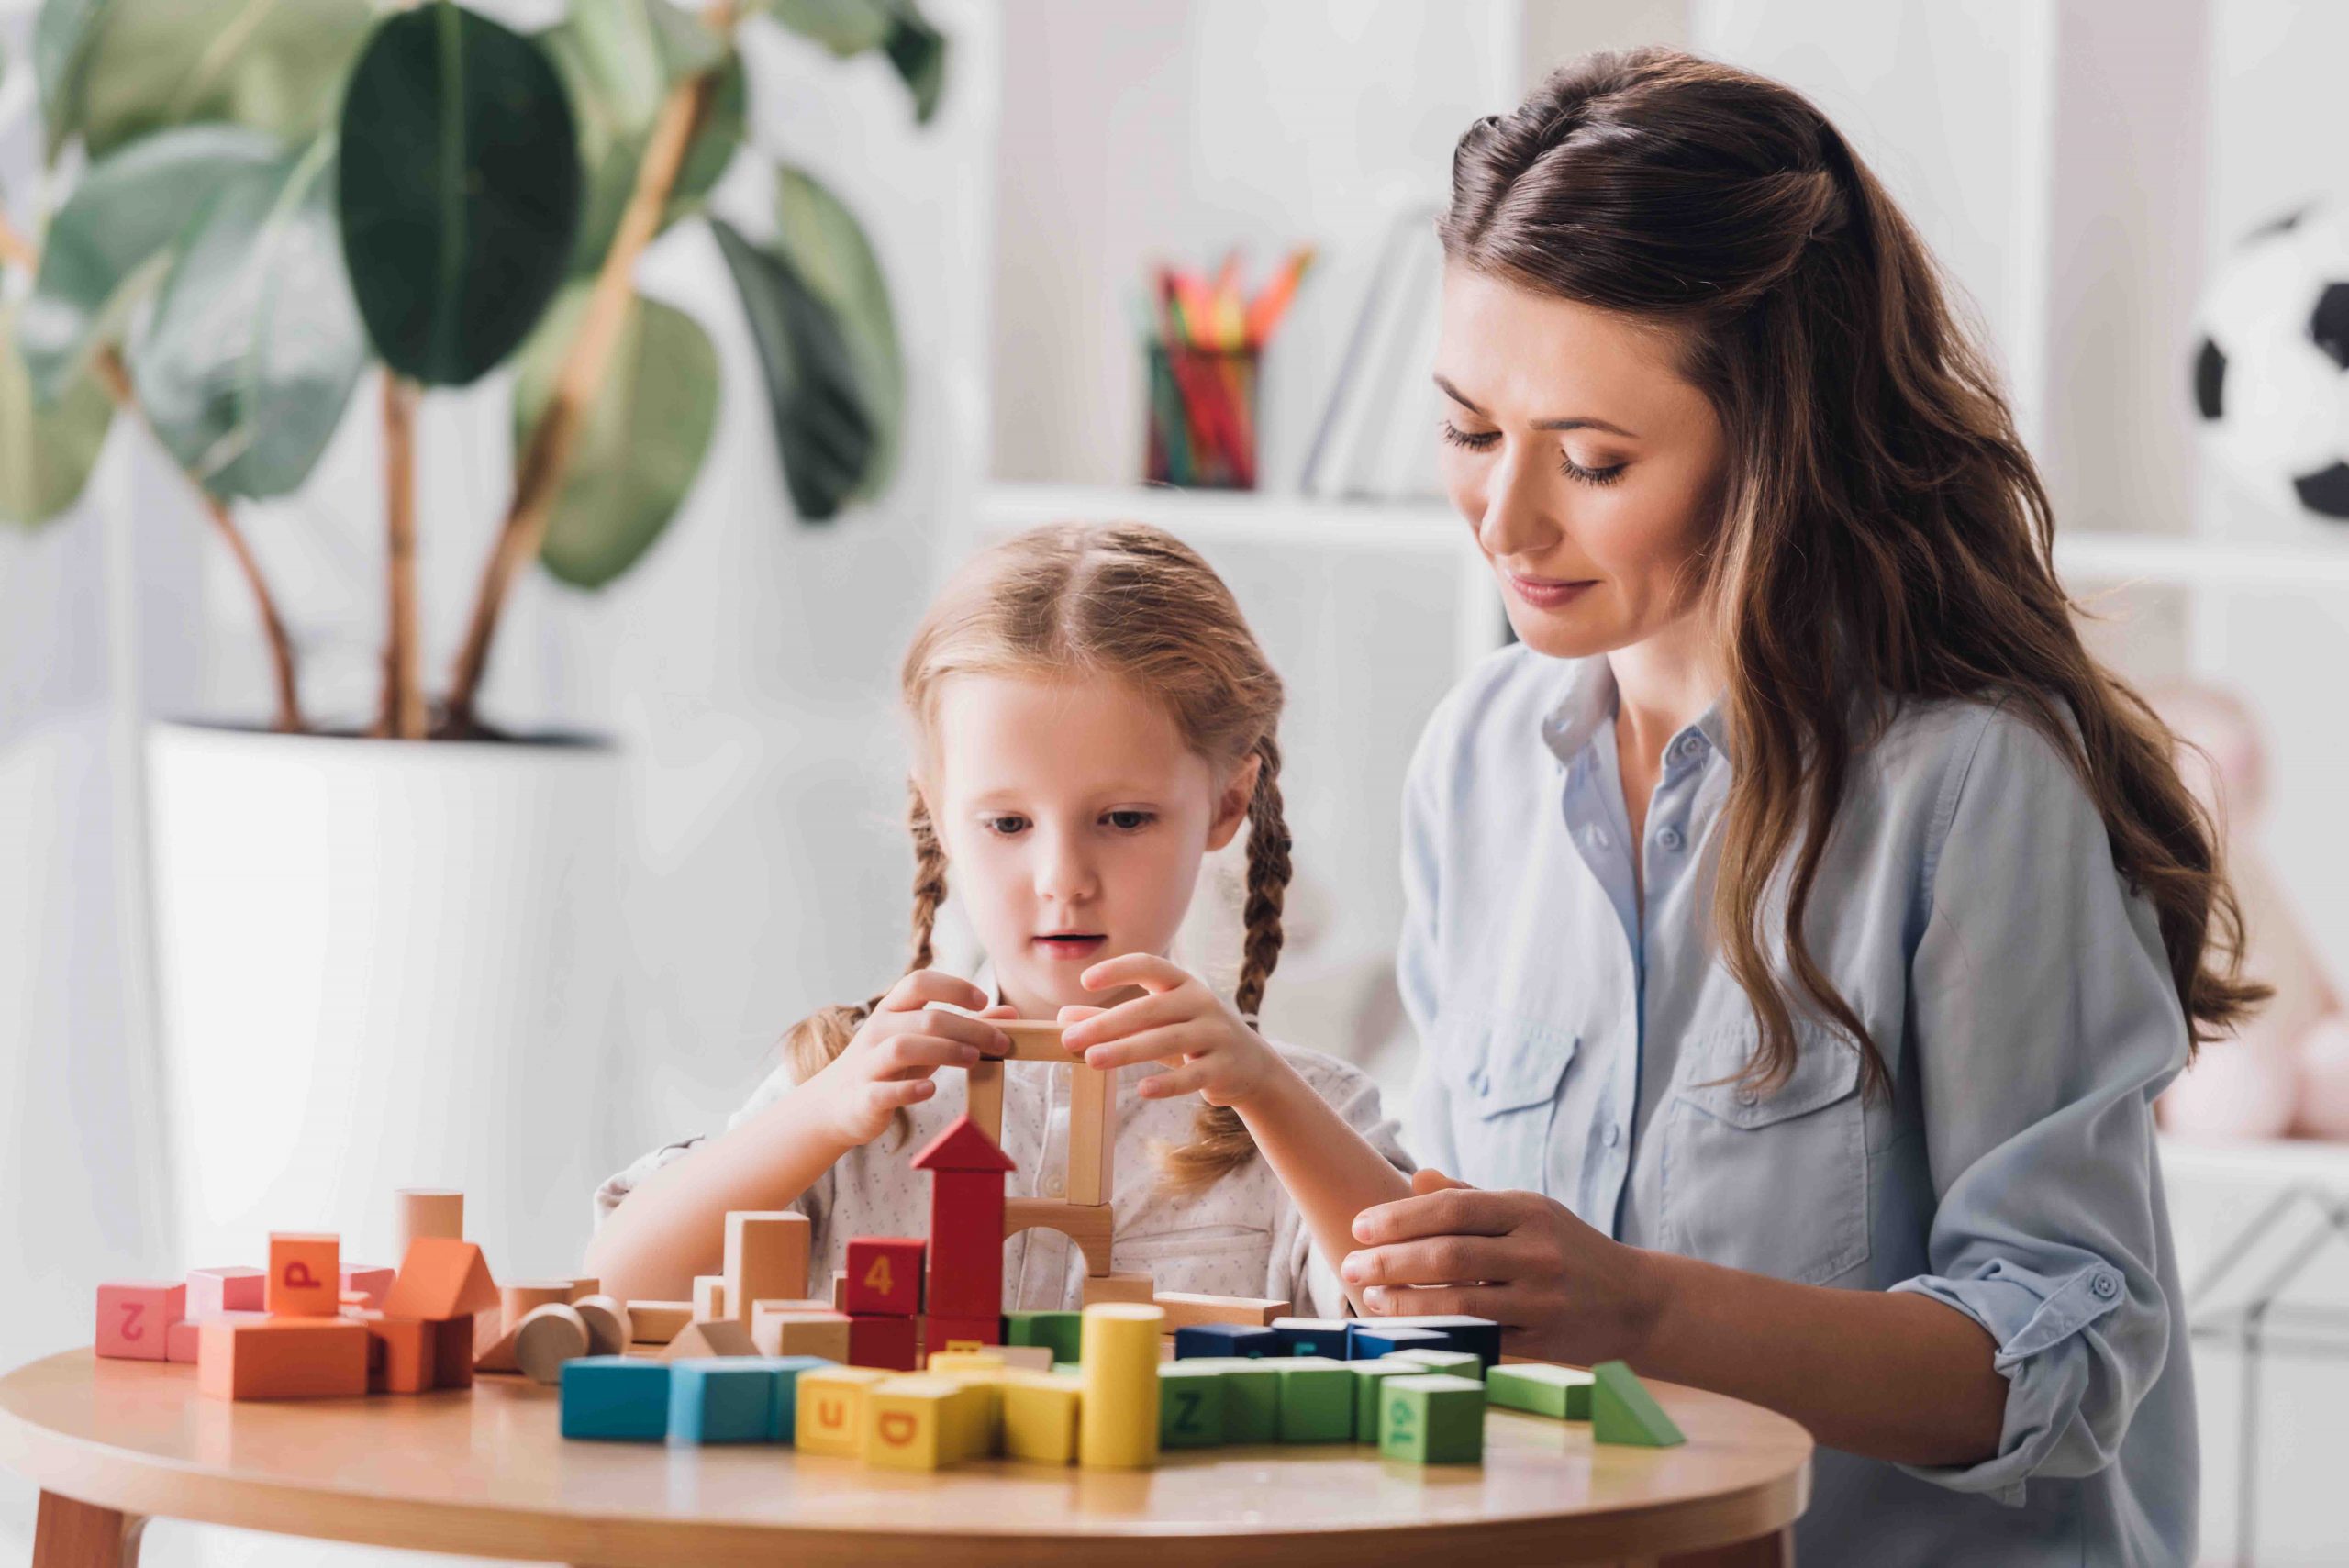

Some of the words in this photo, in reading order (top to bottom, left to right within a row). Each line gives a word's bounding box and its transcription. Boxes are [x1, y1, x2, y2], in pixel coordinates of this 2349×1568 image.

[284, 1262, 320, 1288] P
[864, 1256, 894, 1296] 4
[120, 1303, 145, 1340] 2
[878, 1411, 918, 1447] D
